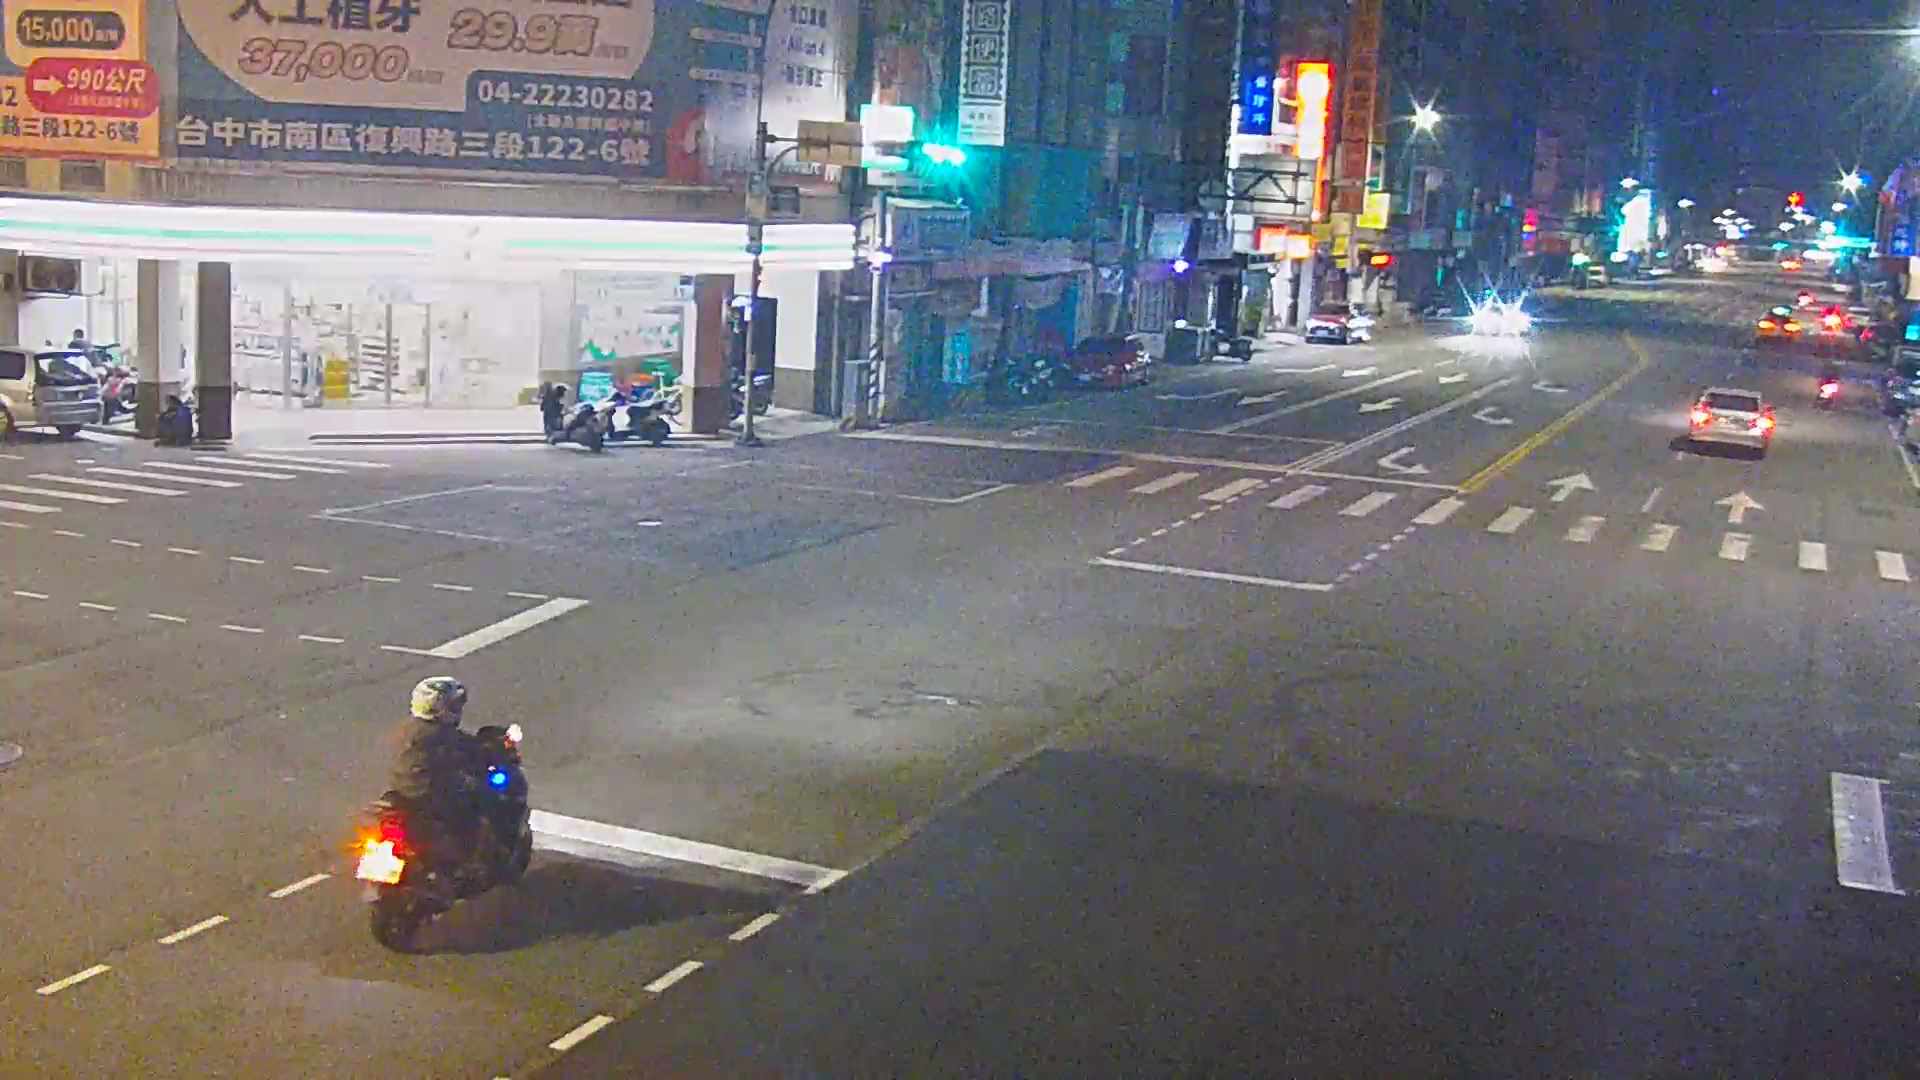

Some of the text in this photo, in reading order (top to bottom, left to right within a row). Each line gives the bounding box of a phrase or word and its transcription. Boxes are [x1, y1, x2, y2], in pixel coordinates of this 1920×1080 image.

[238, 37, 409, 83] 37,000
[66, 67, 146, 95] 990公尺
[477, 79, 654, 112] 04-22230282
[176, 115, 650, 166] 台中市南區復興路三段122-6號
